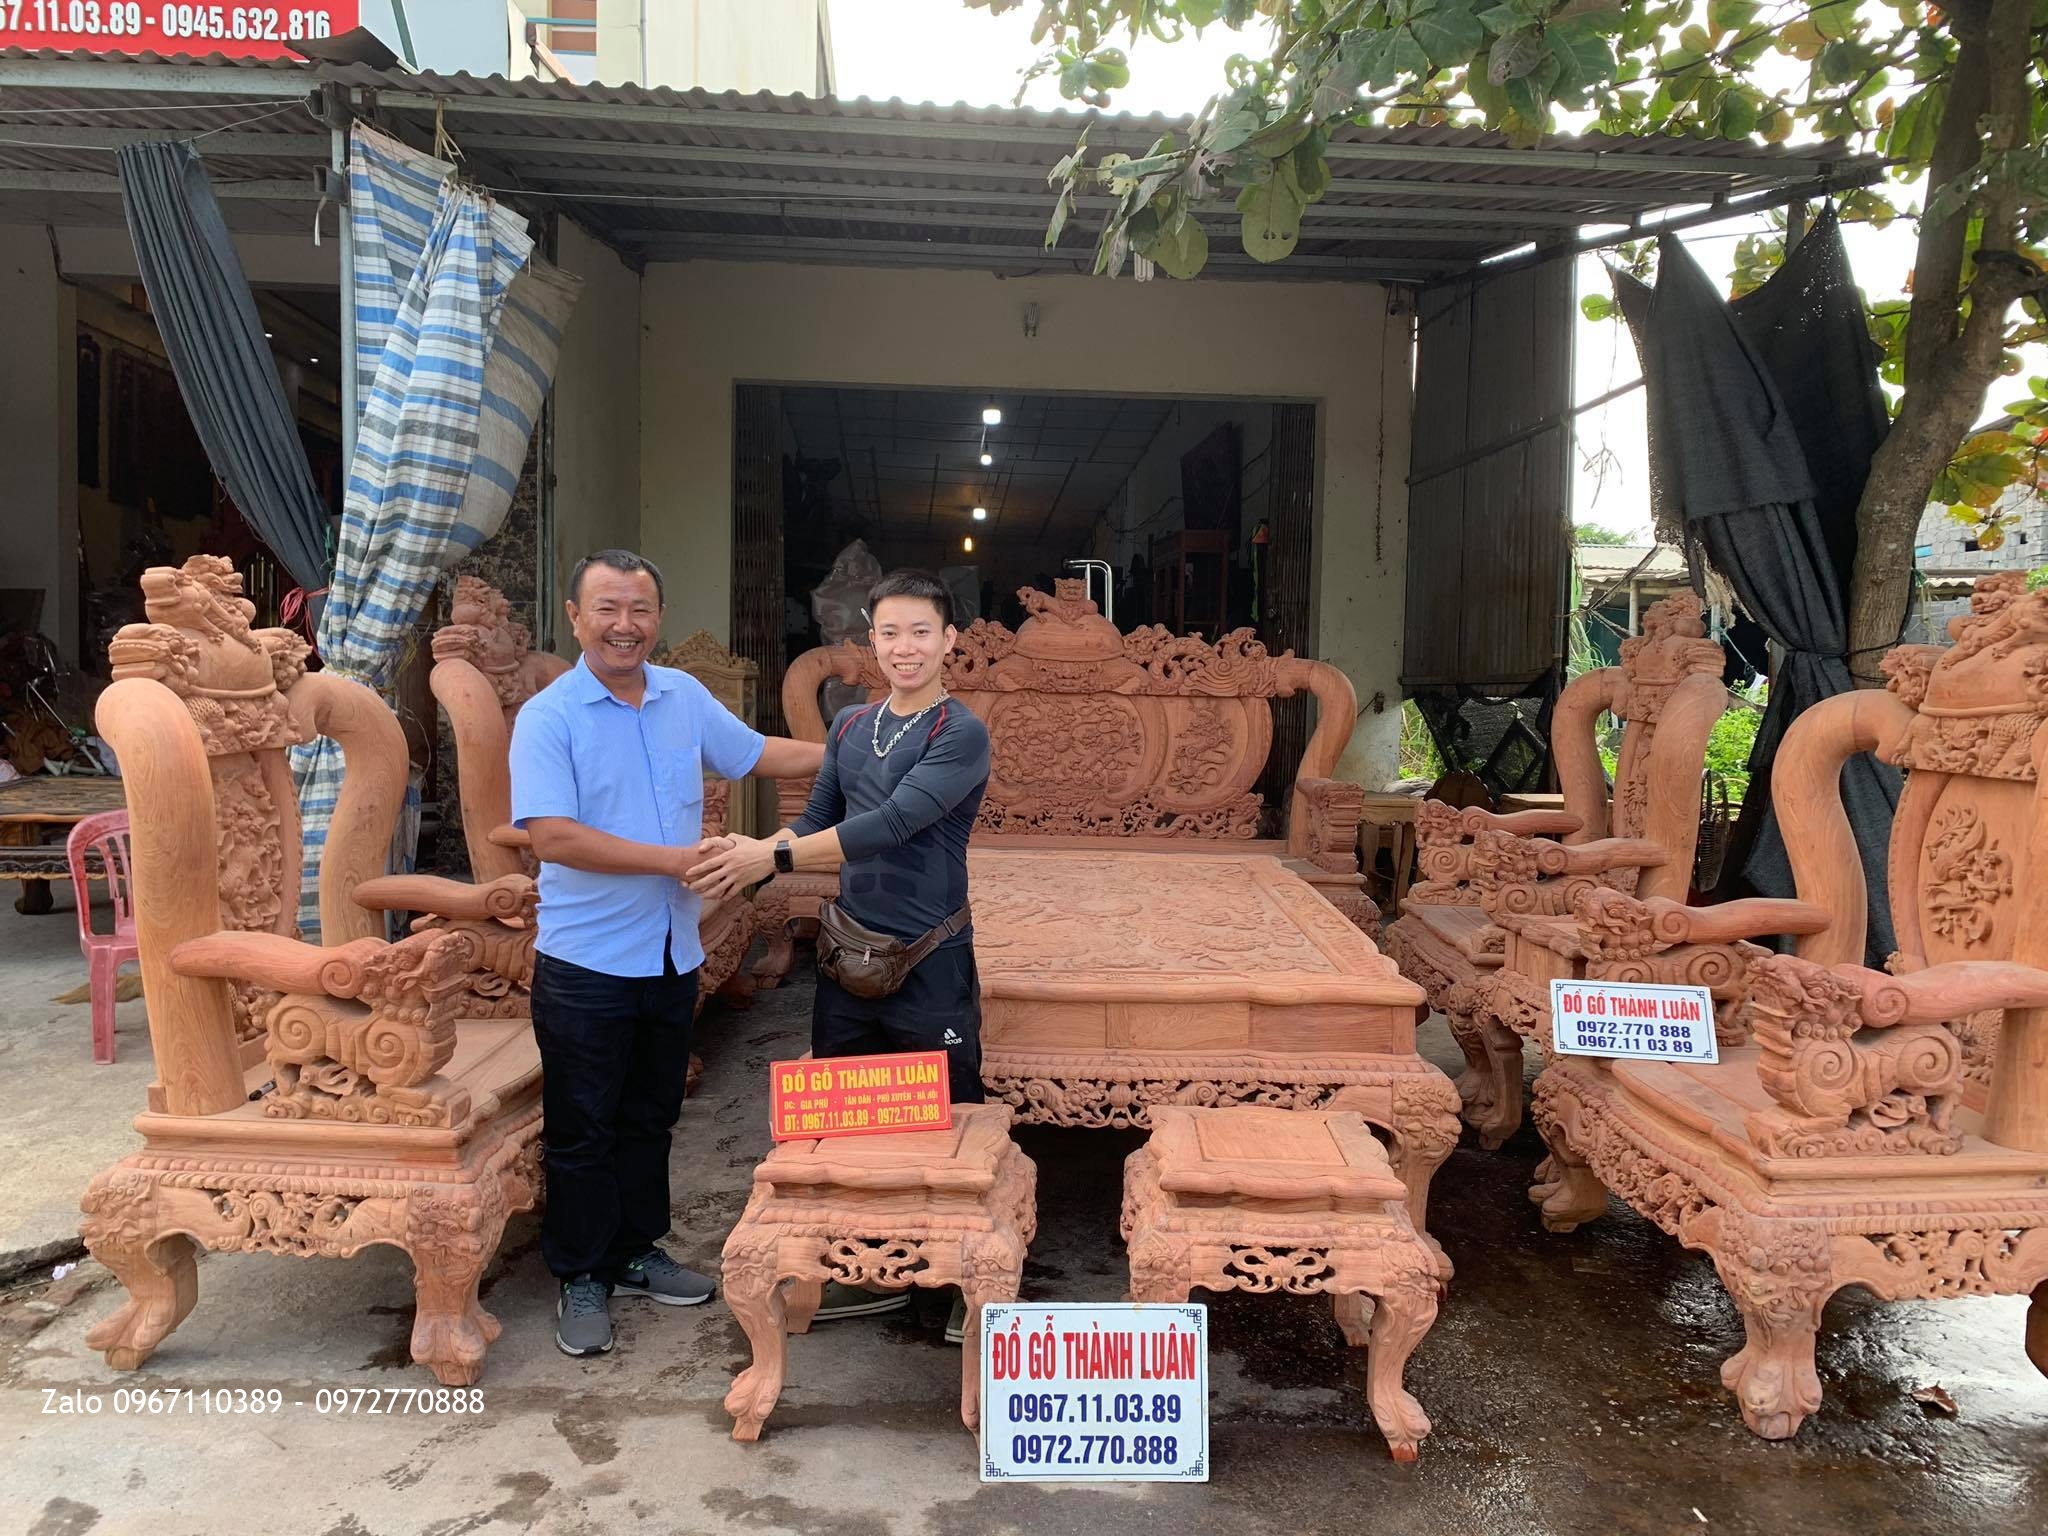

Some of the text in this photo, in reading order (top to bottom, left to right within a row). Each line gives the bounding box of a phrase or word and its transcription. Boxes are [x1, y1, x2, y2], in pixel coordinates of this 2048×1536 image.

[145, 16, 155, 25] -
[162, 3, 331, 40] 0945.632.816
[1563, 988, 1701, 1021] ĐỒ GỖ THÀNH LUÂN
[782, 1060, 939, 1094] ĐỒ GỖ THÀNH LUÂN
[784, 1114, 799, 1131] ĐT:
[802, 1109, 868, 1130] 0967.11.03.89
[878, 1103, 940, 1125] 0972.770.888
[992, 1314, 1196, 1380] ĐỒ GỖ THÀNH LUÂN
[1008, 1393, 1181, 1422] 0967.11.03.89
[1012, 1435, 1178, 1465] 0972.770.888
